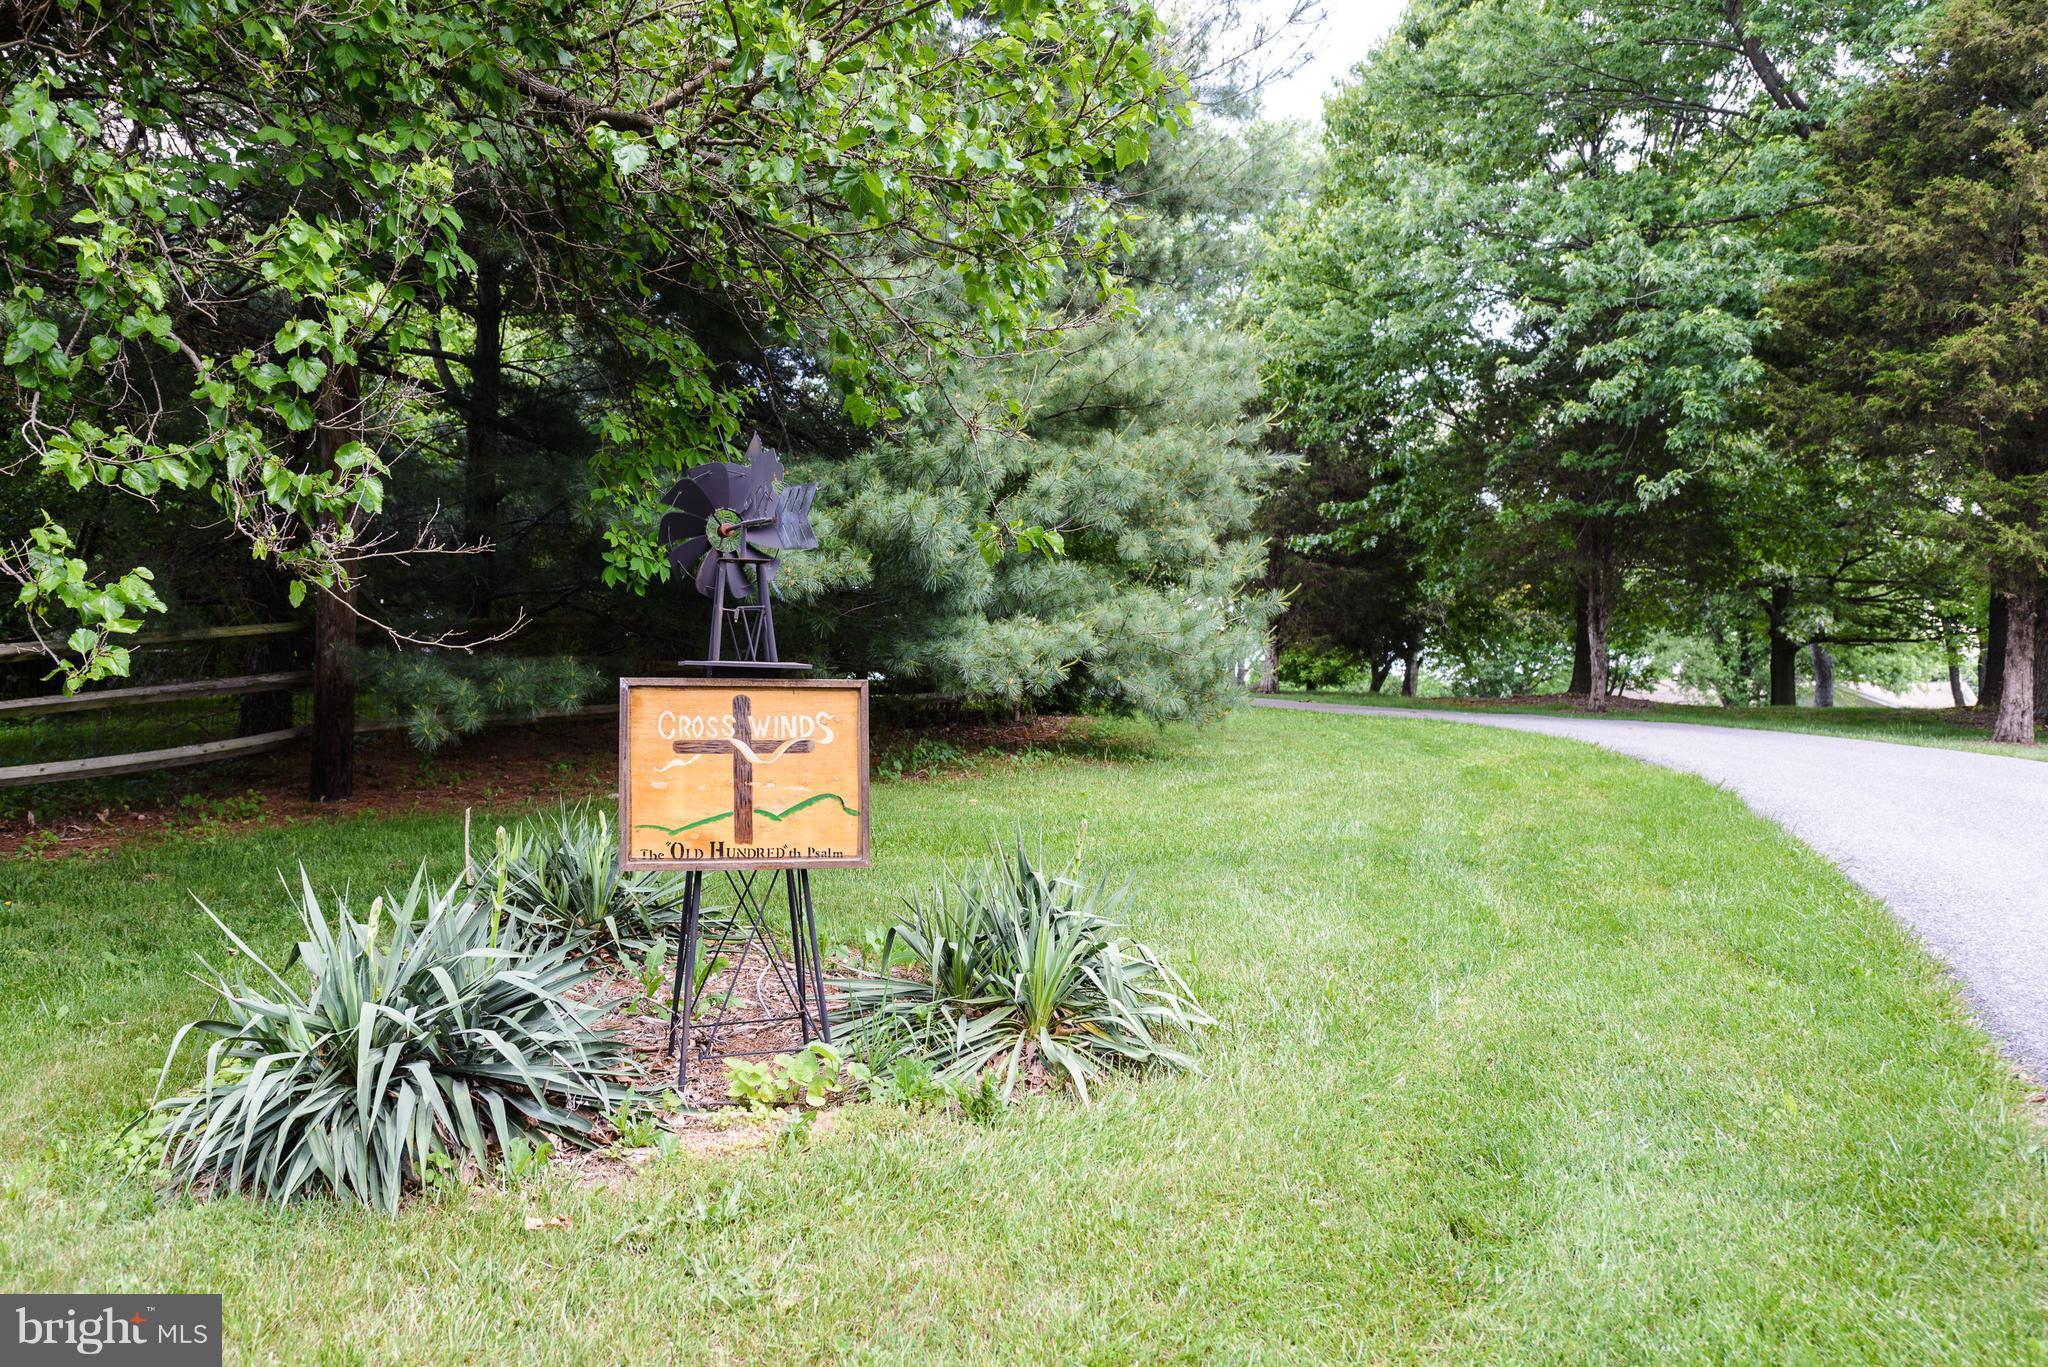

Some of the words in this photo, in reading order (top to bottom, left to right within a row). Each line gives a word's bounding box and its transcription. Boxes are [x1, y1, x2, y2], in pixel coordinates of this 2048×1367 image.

[658, 711, 736, 739] CROSS
[749, 711, 840, 744] WINDS
[639, 848, 665, 860] The
[807, 847, 844, 859] Psalm
